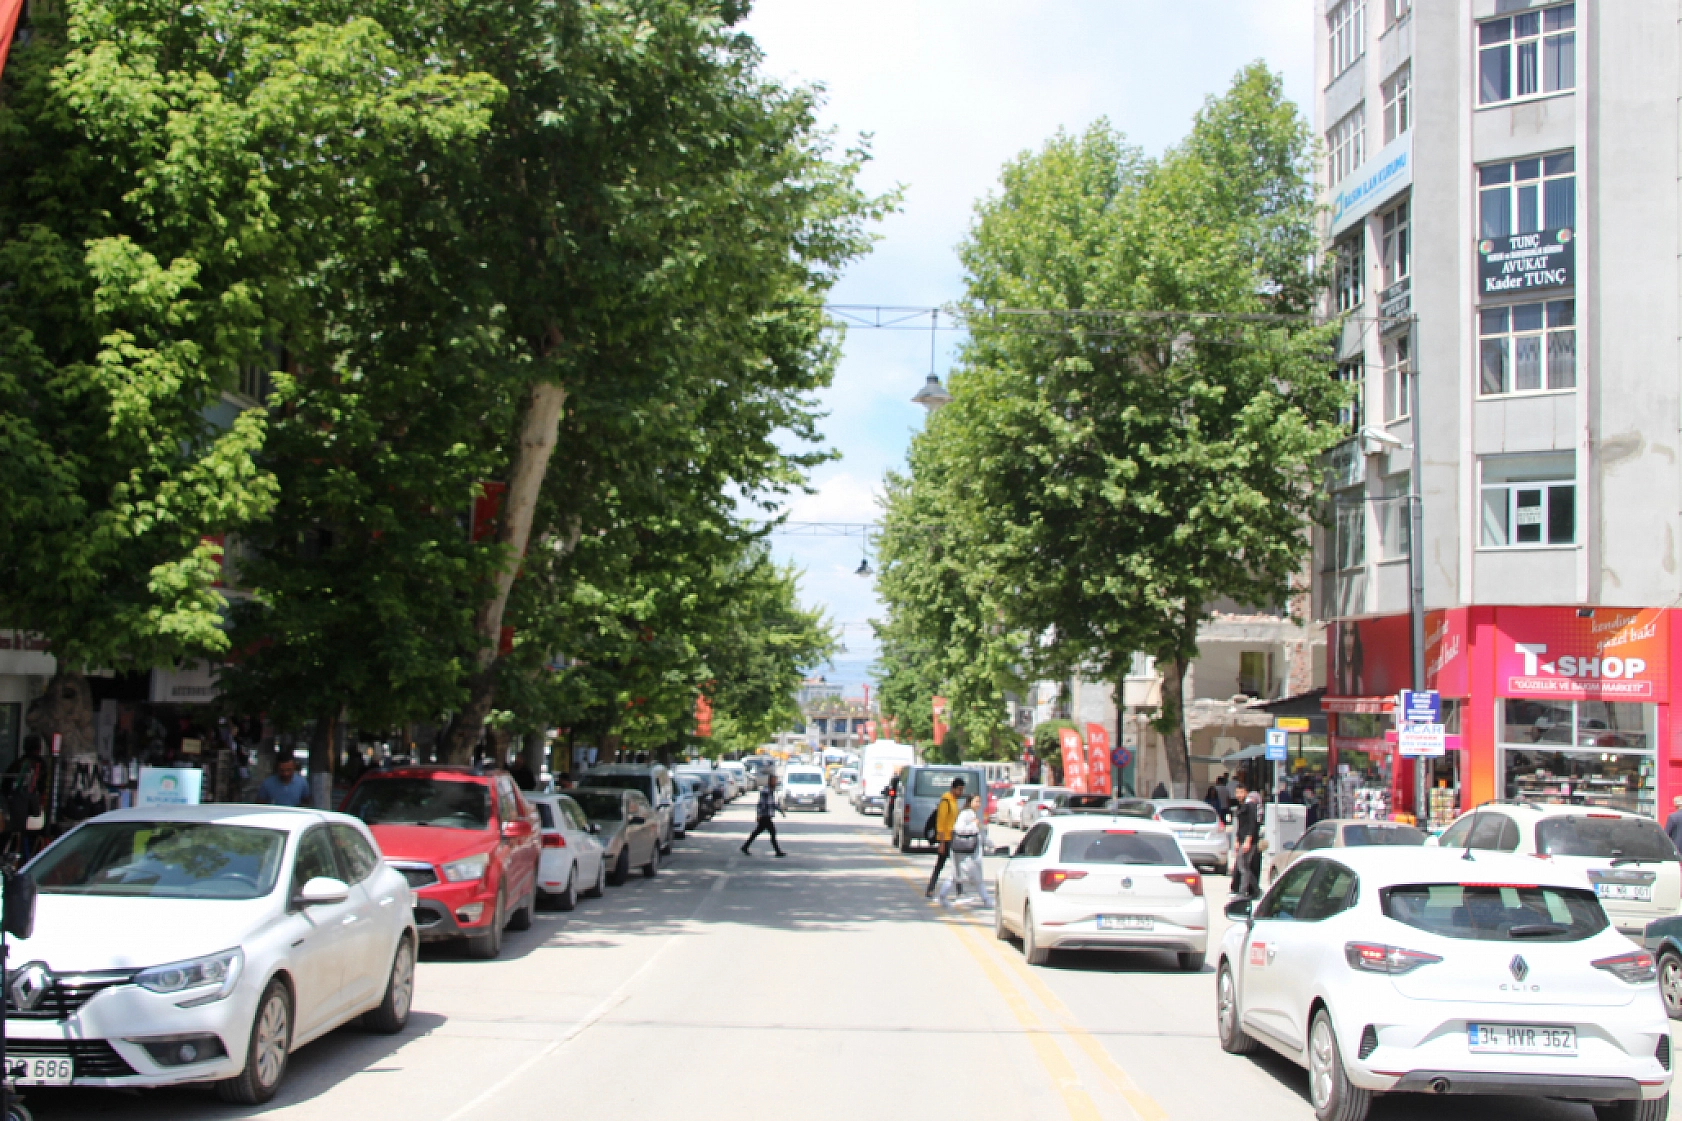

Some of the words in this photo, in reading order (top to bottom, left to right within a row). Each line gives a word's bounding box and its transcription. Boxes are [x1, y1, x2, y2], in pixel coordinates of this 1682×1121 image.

[1509, 234, 1540, 249] TUNÇ
[1502, 256, 1549, 273] AVUKAT
[1486, 275, 1523, 292] Kader
[1525, 268, 1567, 286] TUNÇ
[1630, 624, 1657, 642] bak!
[1403, 724, 1442, 734] ACAR
[1499, 983, 1541, 992] CLIO
[1480, 1027, 1498, 1045] 34
[1506, 1027, 1536, 1047] HVR
[1542, 1030, 1571, 1048] 362
[34, 1059, 70, 1078] 686
